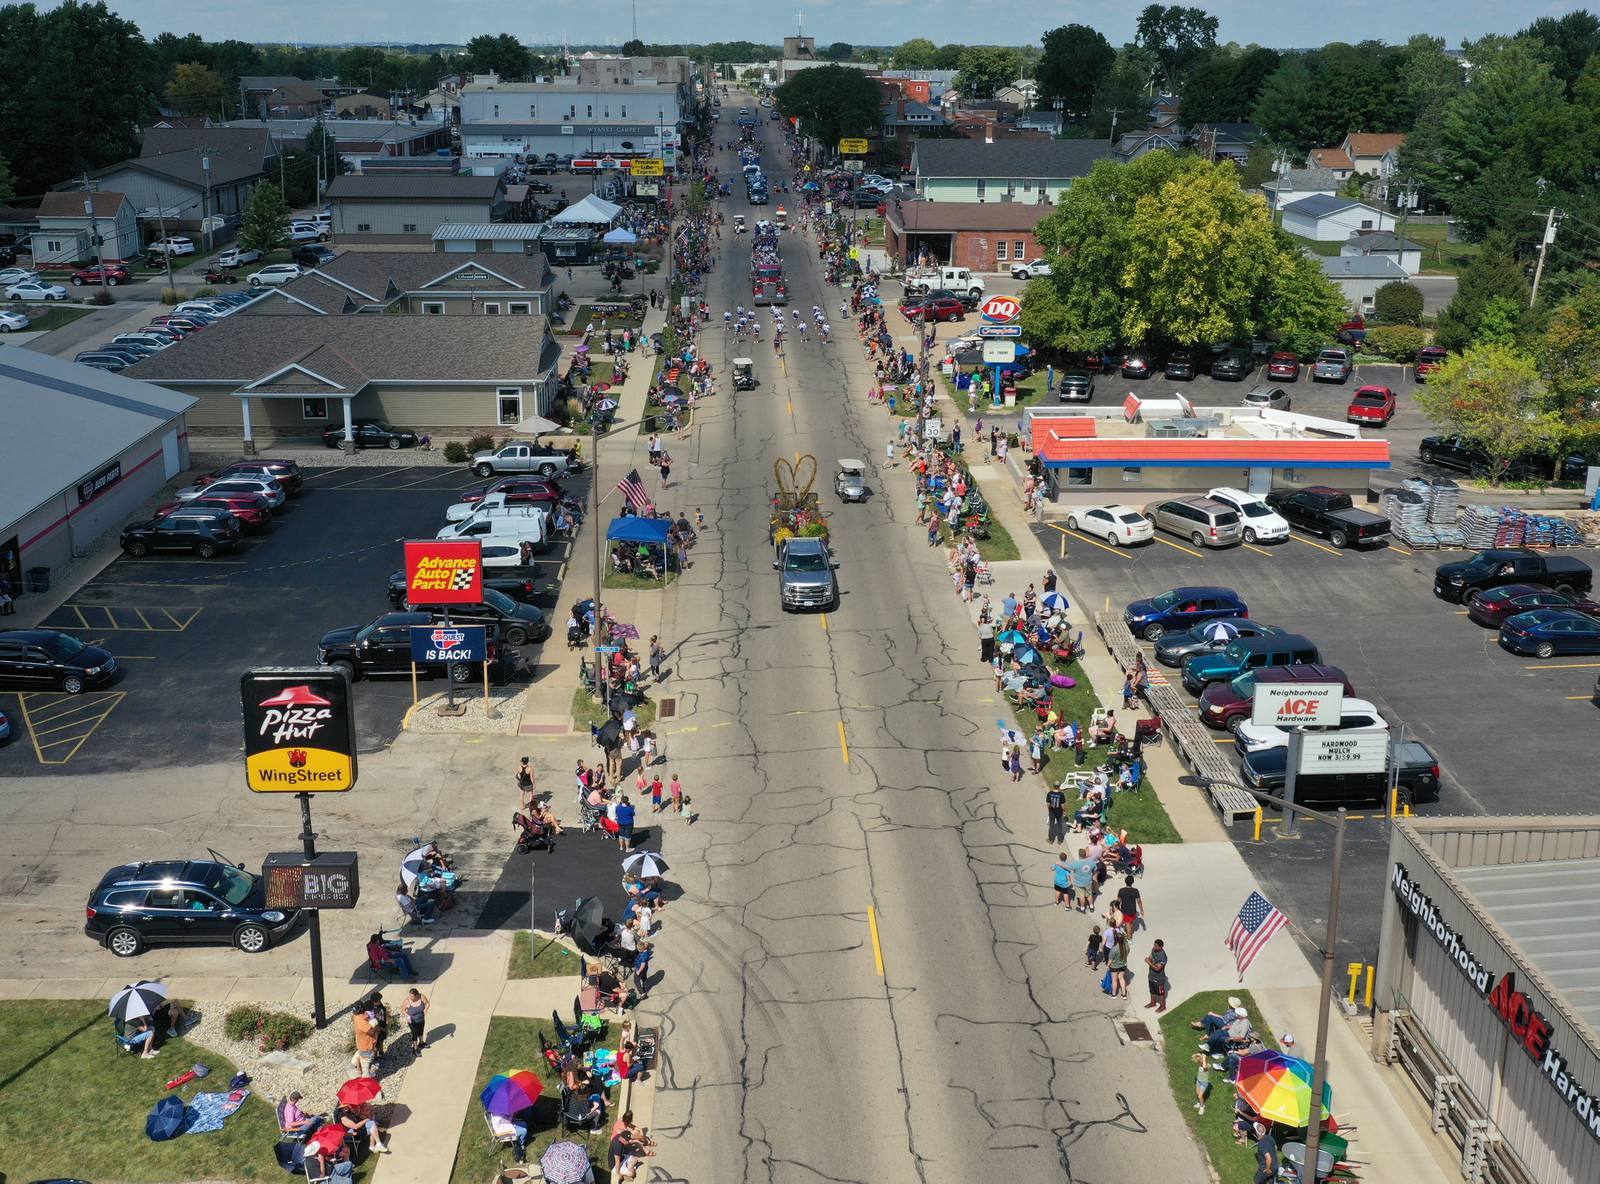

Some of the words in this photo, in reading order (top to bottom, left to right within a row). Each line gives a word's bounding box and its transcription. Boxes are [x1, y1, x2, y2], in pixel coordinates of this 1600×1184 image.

[987, 301, 1015, 318] DQ
[927, 428, 939, 436] 30
[94, 475, 107, 490] AUTO
[106, 466, 119, 482] PARTS
[417, 557, 476, 568] Advance
[414, 568, 450, 579] Auto
[411, 579, 447, 590] Parts
[425, 649, 436, 660] IS
[438, 649, 472, 660] BACK!
[1269, 689, 1329, 697] Neighborhood
[1276, 697, 1320, 715] ACE
[260, 701, 333, 736] Pizza
[272, 722, 325, 745] Hut
[1321, 740, 1358, 748] HARDWOOD
[259, 769, 342, 784] WingStreet
[304, 873, 349, 894] BIG
[1391, 863, 1494, 995] Neighborhood
[1487, 972, 1552, 1063] ACE
